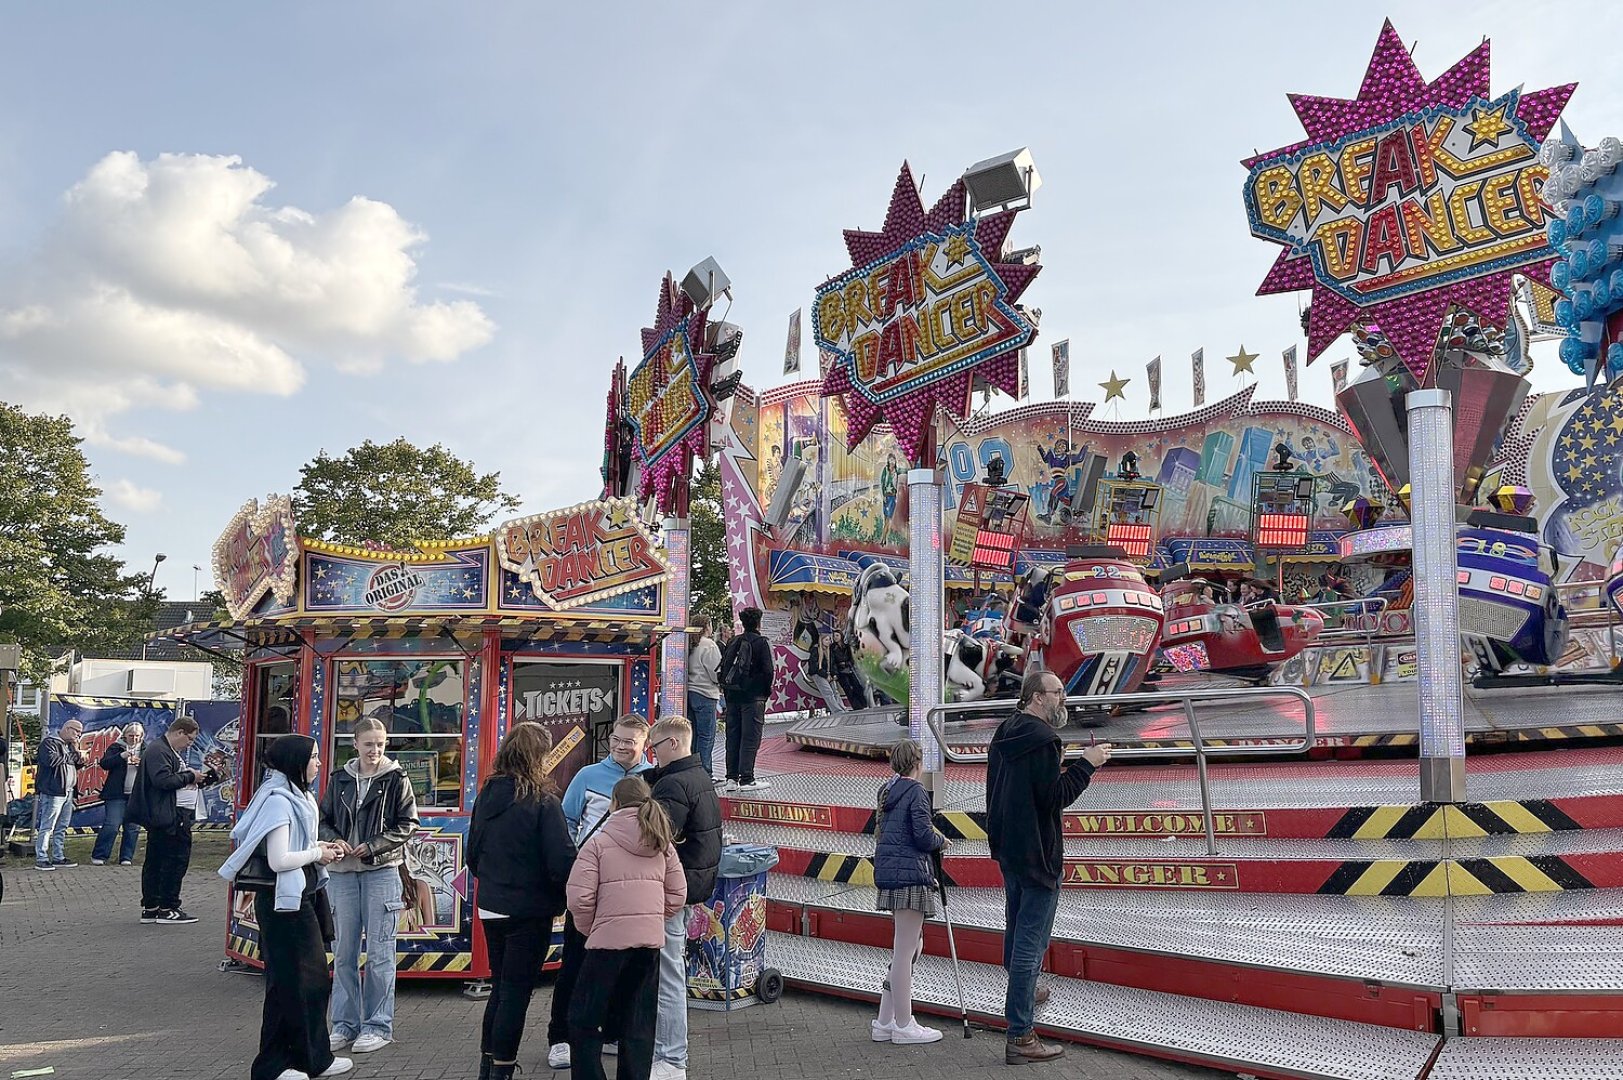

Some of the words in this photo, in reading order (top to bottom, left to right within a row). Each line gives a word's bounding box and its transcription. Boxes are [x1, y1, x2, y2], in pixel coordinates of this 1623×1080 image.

[1253, 115, 1535, 232] BREAK
[1314, 163, 1557, 281] DANCER
[818, 242, 988, 344] BREAK
[851, 278, 1018, 386] DANCER
[505, 509, 637, 566] BREAK
[1477, 539, 1507, 557] 18
[375, 568, 398, 586] DAS
[533, 536, 664, 593] DANCER
[1091, 565, 1122, 579] 22
[365, 574, 421, 605] ORIGINAL
[523, 687, 604, 720] TICKETS
[740, 802, 764, 818] GET
[768, 805, 817, 823] READY!
[1062, 864, 1211, 886] ANGER
